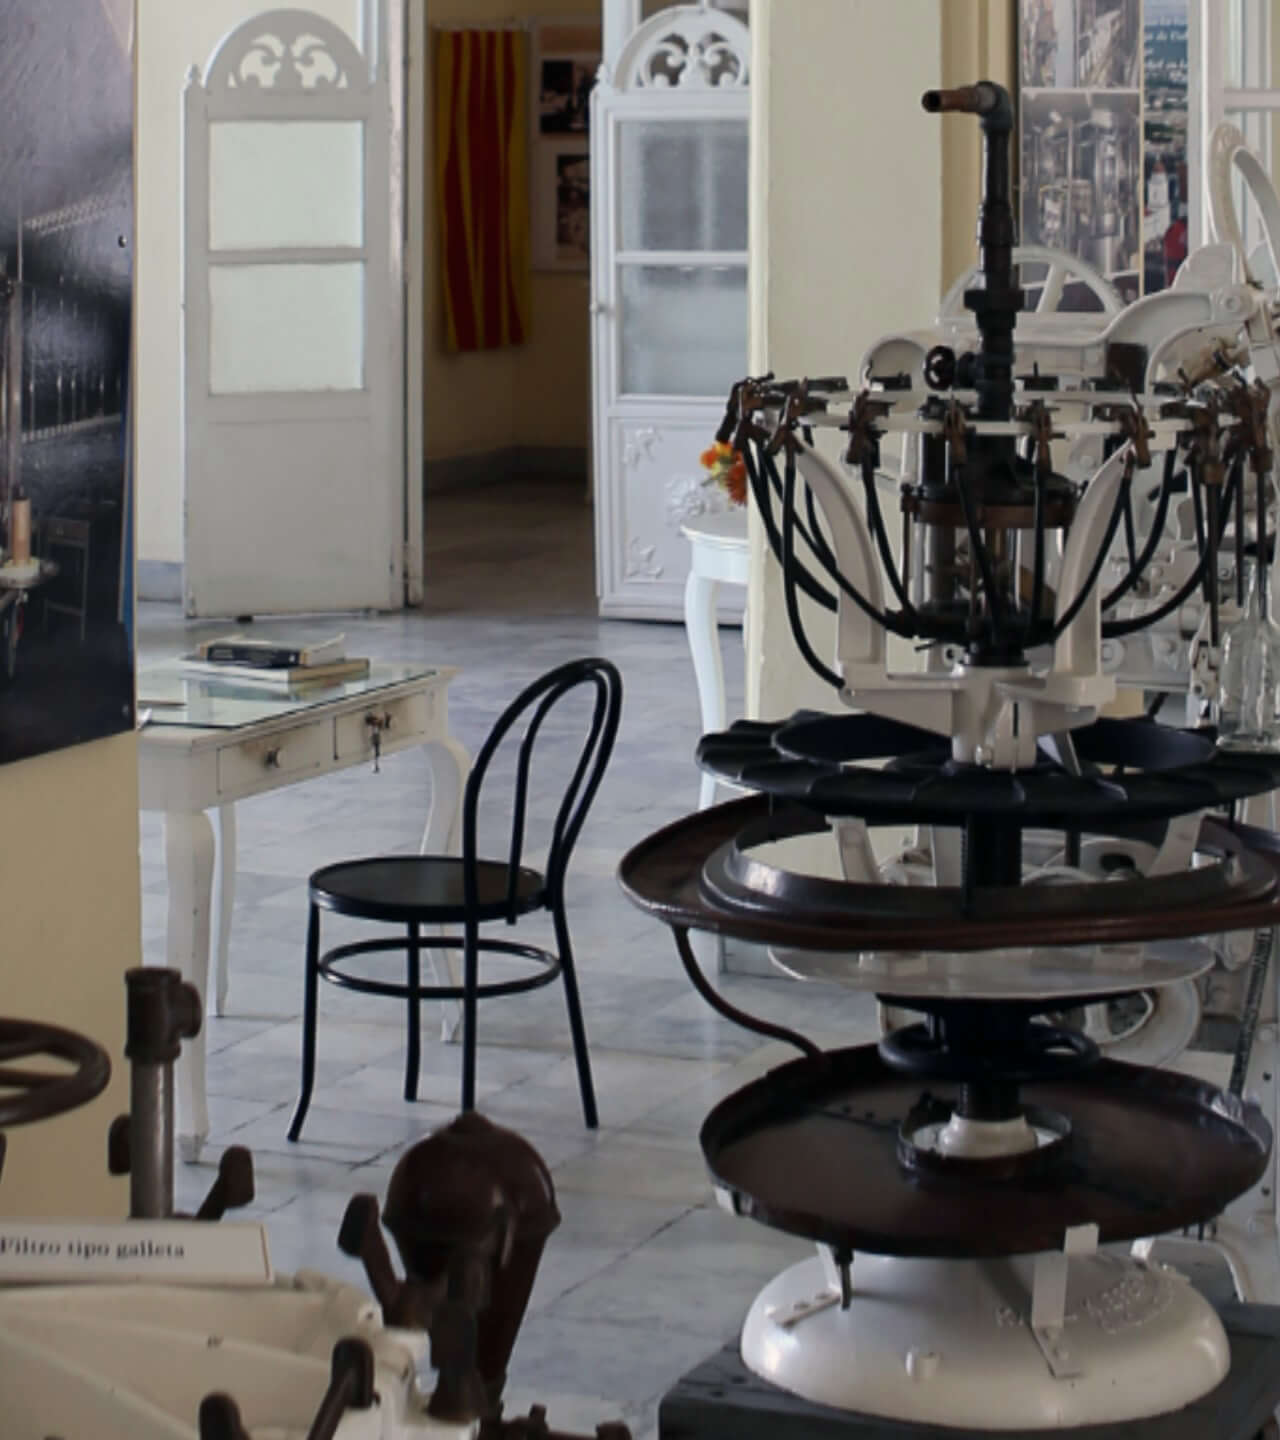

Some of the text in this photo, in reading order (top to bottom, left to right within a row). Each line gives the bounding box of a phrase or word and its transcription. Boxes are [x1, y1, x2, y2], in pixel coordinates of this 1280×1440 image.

[0, 1235, 185, 1262] Filtro tipo galleta
